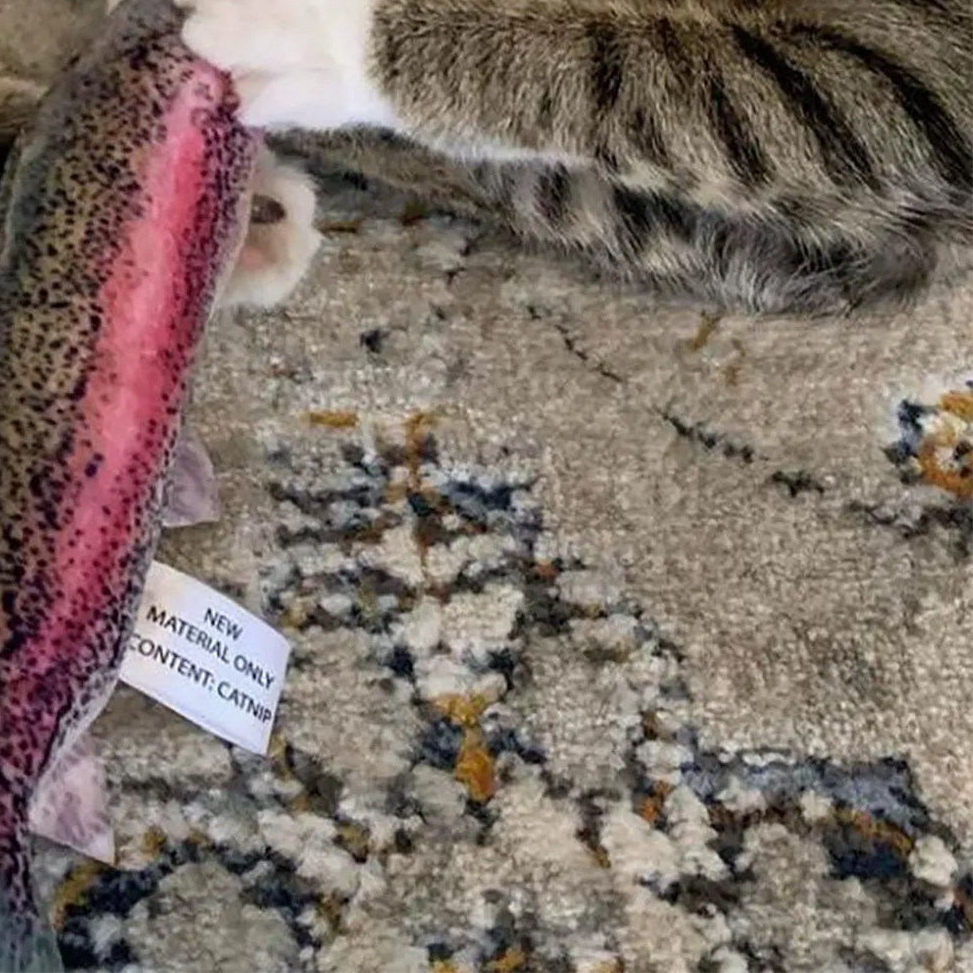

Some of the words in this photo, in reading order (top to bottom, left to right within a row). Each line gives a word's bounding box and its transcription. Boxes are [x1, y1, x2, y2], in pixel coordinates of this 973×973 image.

[204, 607, 243, 641] NEW
[145, 605, 229, 664] MATERIAL
[233, 654, 275, 690] ONLY
[217, 681, 273, 724] CATNIP
